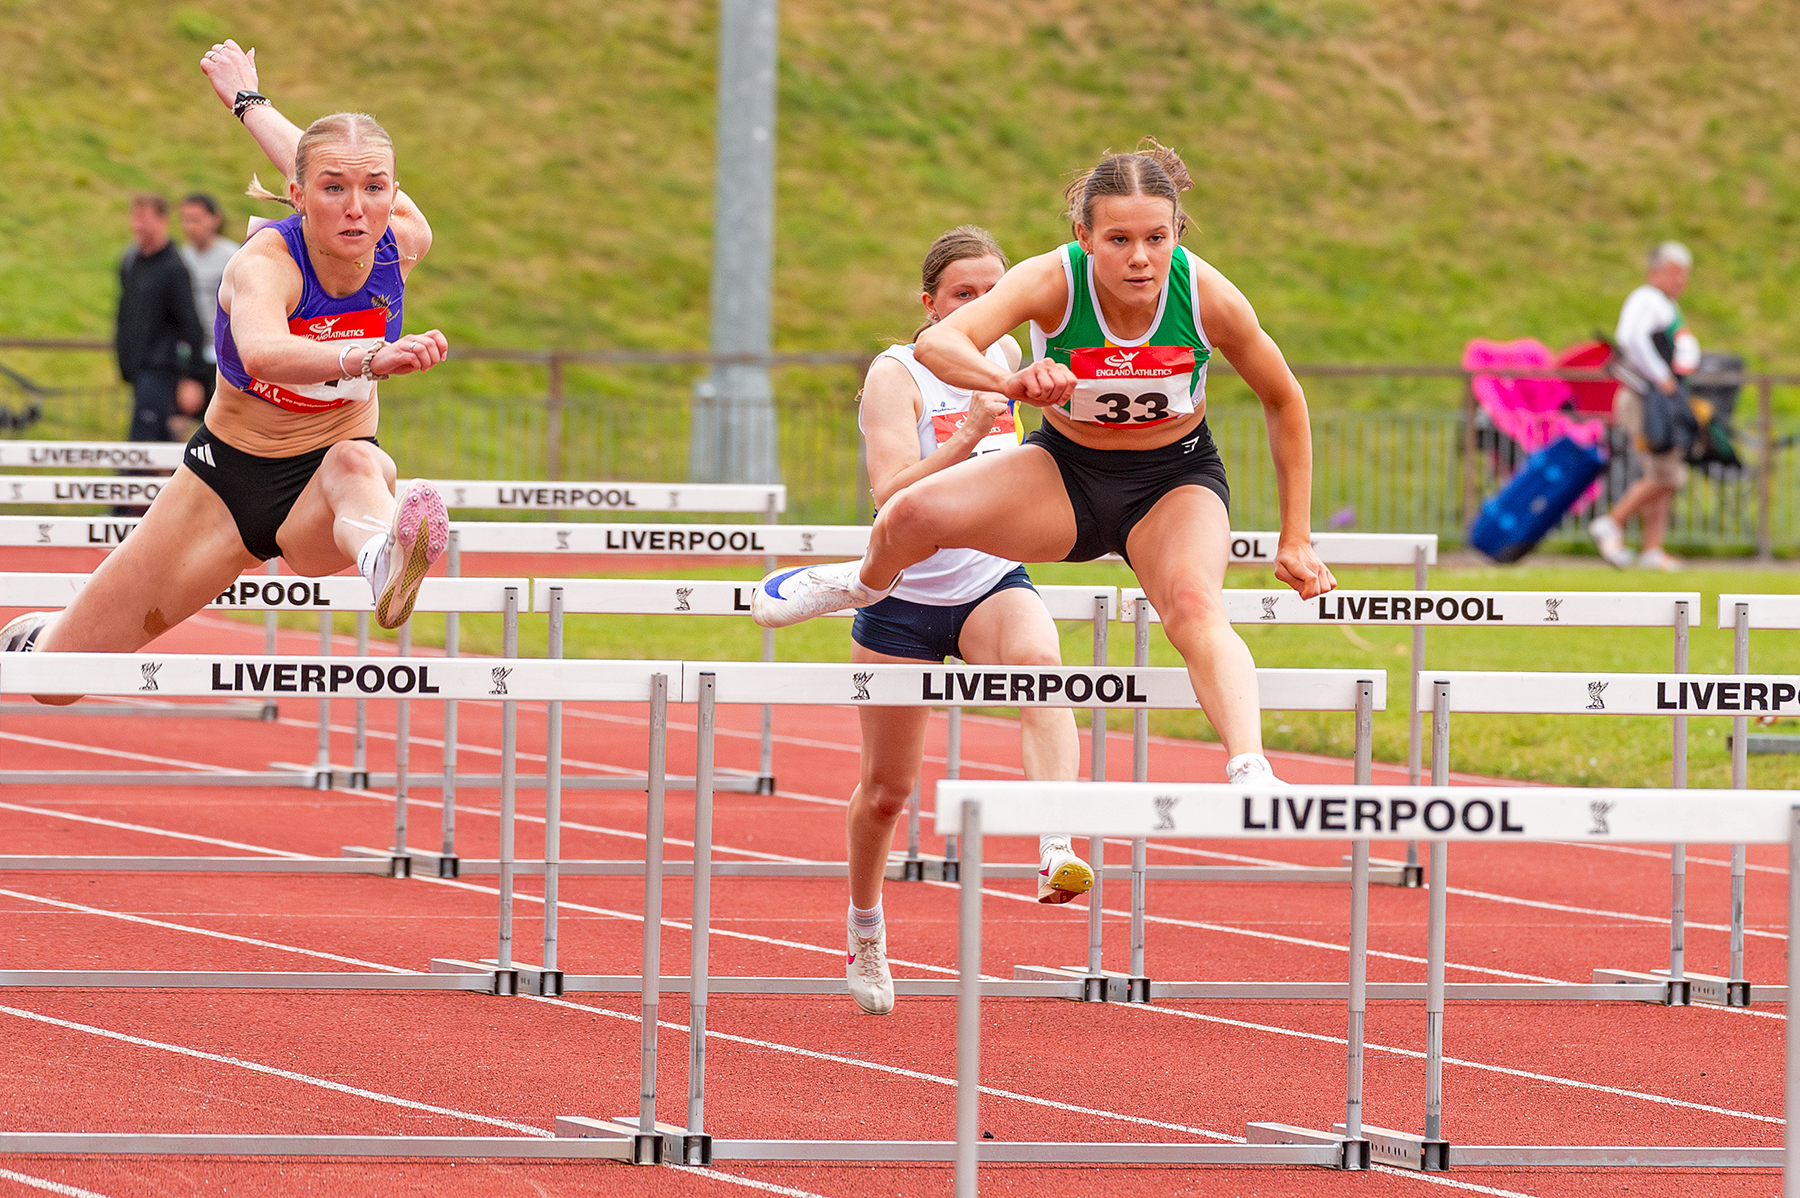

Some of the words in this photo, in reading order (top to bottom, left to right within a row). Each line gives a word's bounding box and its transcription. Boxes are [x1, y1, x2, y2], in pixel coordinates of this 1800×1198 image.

[330, 328, 364, 339] ATHLETICS
[1096, 368, 1131, 377] ENGLAND
[1133, 368, 1172, 376] ATHLETICS
[1094, 392, 1169, 423] 33
[30, 449, 155, 463] LIVERPOOL
[54, 483, 160, 500] LIVERPO
[498, 489, 636, 506] LIVERPOOL
[606, 530, 765, 550] LIVERPOOL
[215, 582, 330, 605] RPOOL
[1319, 597, 1504, 621] LIVERPOOL
[213, 664, 440, 694] LIVERPOOL
[922, 673, 1147, 703] LIVERPOOL
[1657, 682, 1800, 710] LIVERP
[1243, 798, 1523, 832] LIVERPOOL
